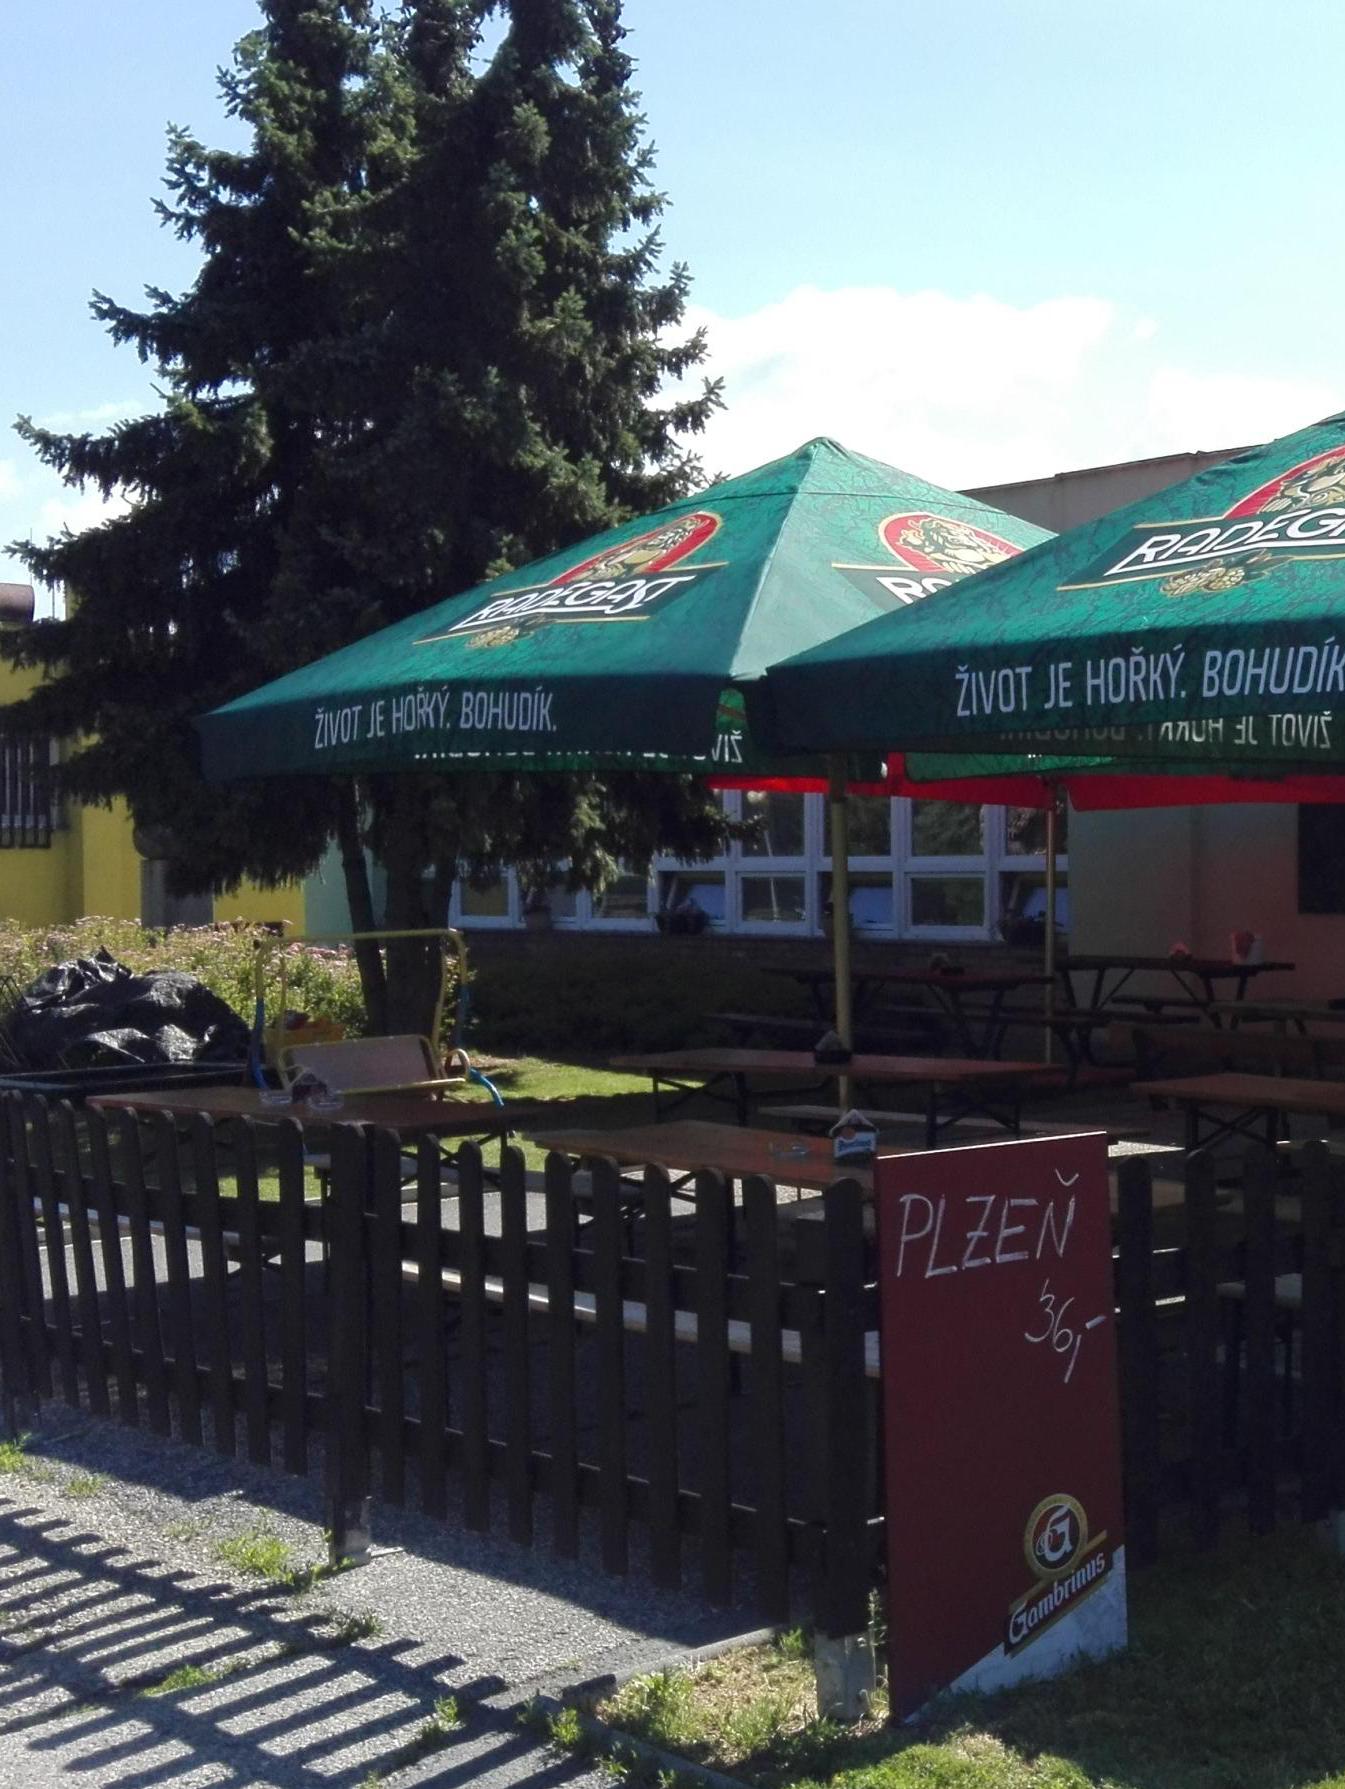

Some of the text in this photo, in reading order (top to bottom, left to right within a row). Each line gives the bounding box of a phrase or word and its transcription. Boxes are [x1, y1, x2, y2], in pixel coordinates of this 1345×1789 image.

[449, 575, 697, 631] RADEGAST
[314, 685, 558, 749] ŽIVOT JE HOŘKÝ. BOHUDÍK.
[955, 665, 1032, 718] ŽIVOT
[1044, 662, 1073, 710] JE
[1086, 644, 1187, 704] HOŘKÝ.
[896, 1168, 1080, 1279] PLZEŇ
[1009, 1551, 1107, 1644] Gambrinus
